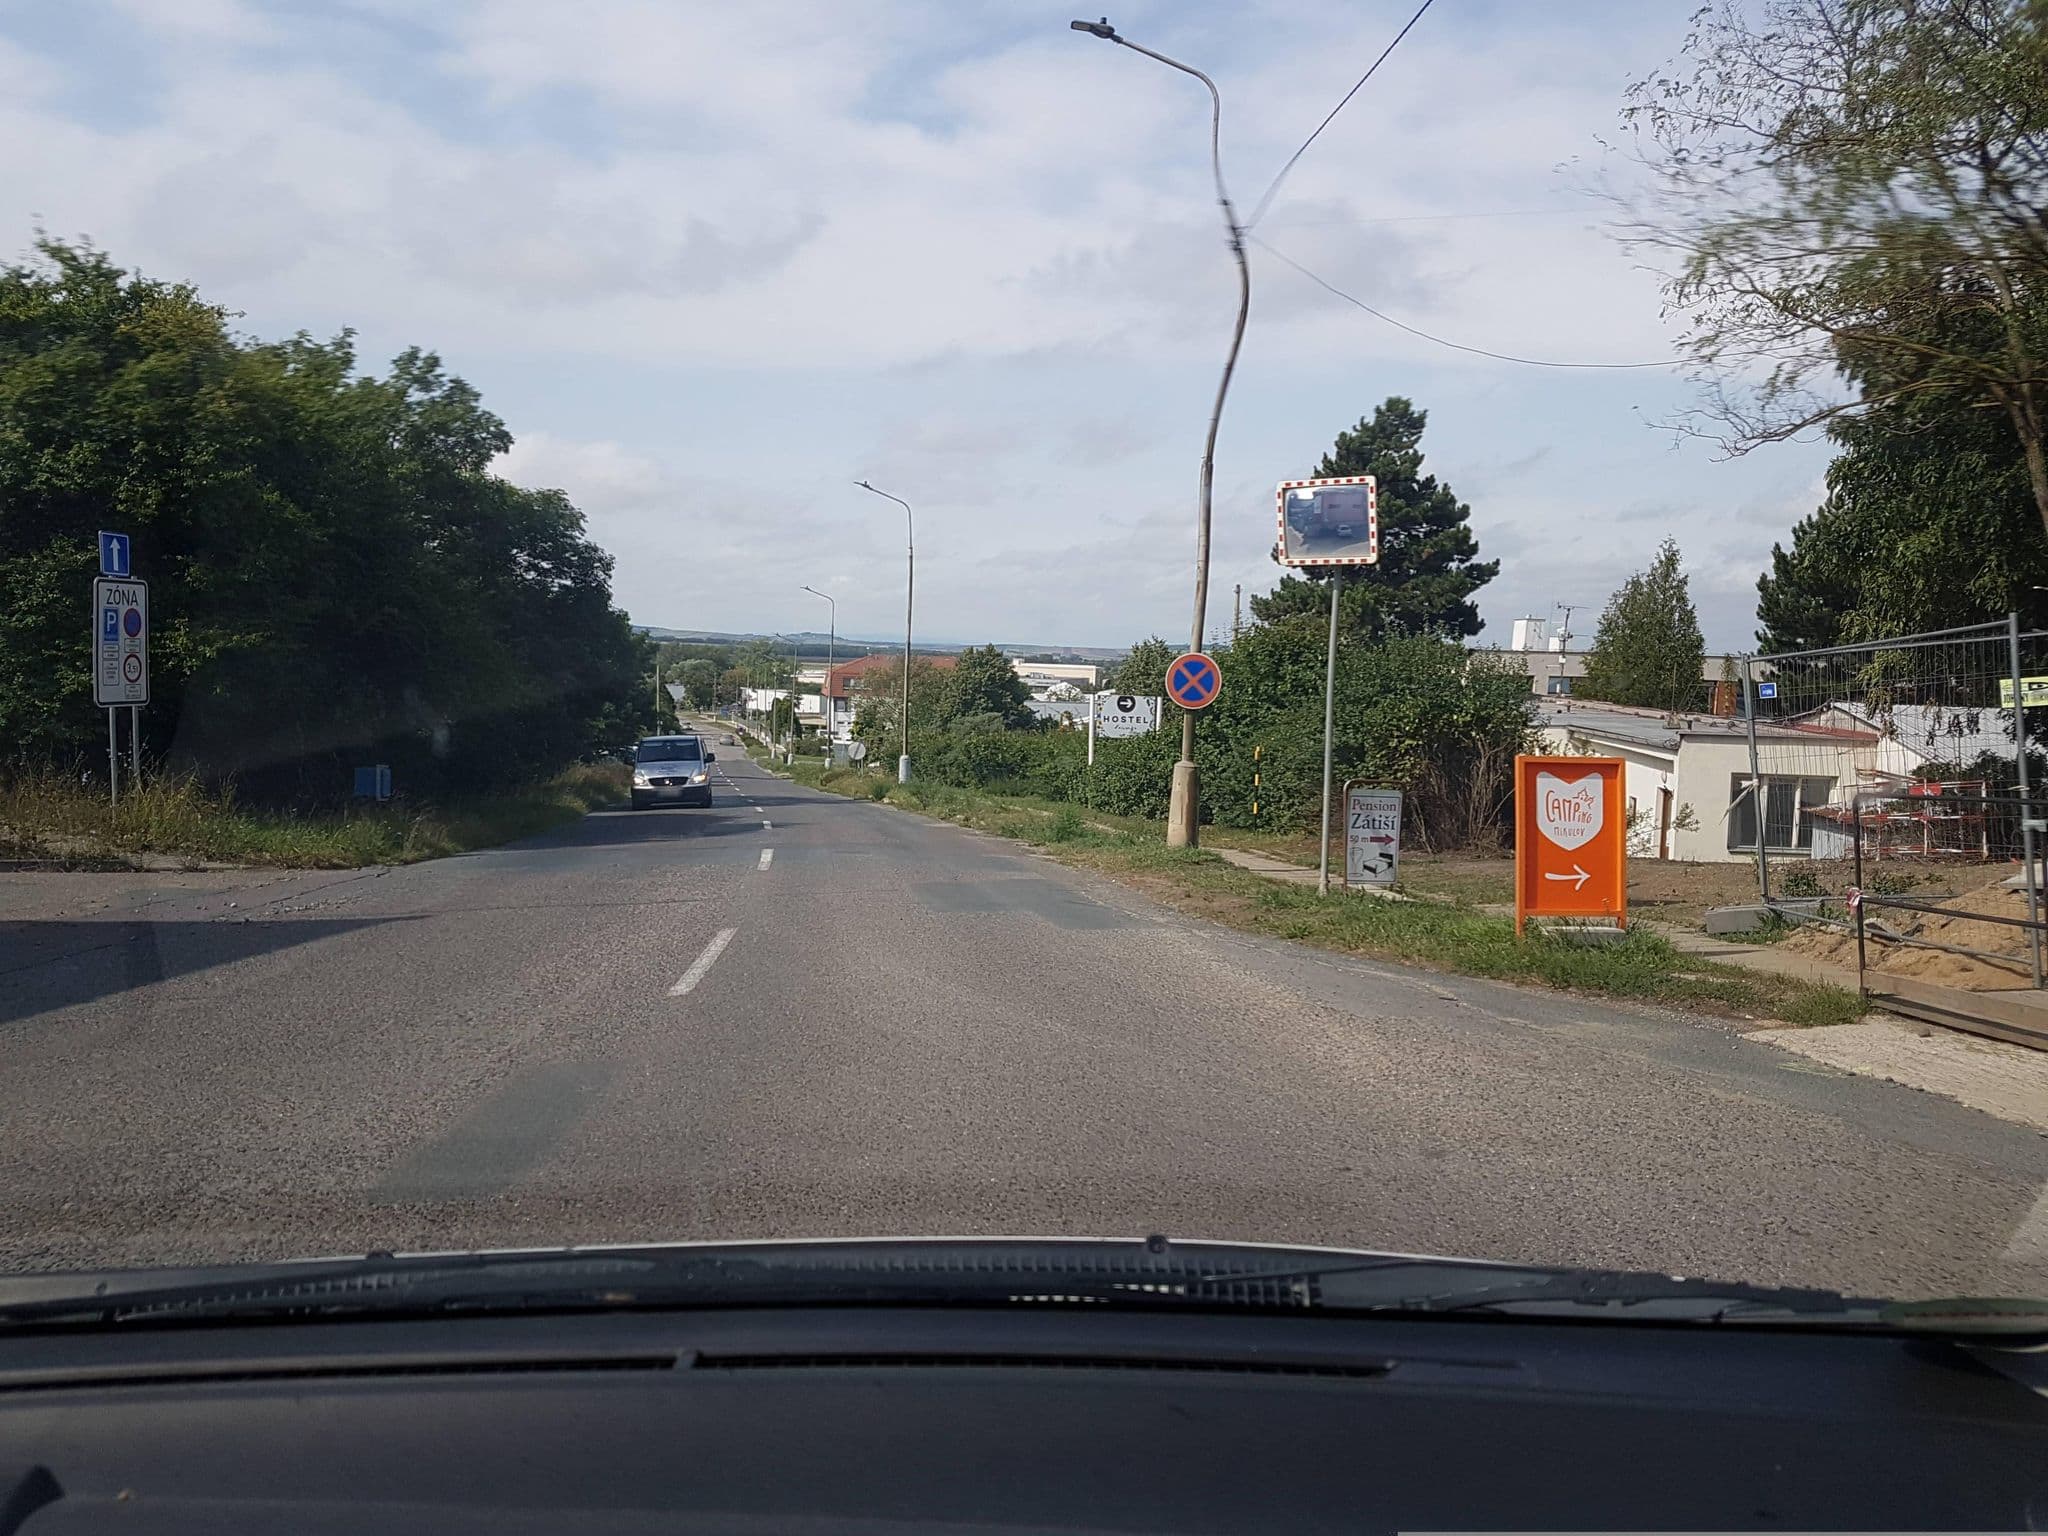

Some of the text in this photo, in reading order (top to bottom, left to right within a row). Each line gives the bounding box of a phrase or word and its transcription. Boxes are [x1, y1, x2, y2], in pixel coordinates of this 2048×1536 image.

[106, 585, 139, 606] ZÓNA
[107, 611, 117, 632] P
[1103, 715, 1149, 724] HOSTEL
[1352, 799, 1397, 812] Pension
[1351, 813, 1397, 830] Zátiší
